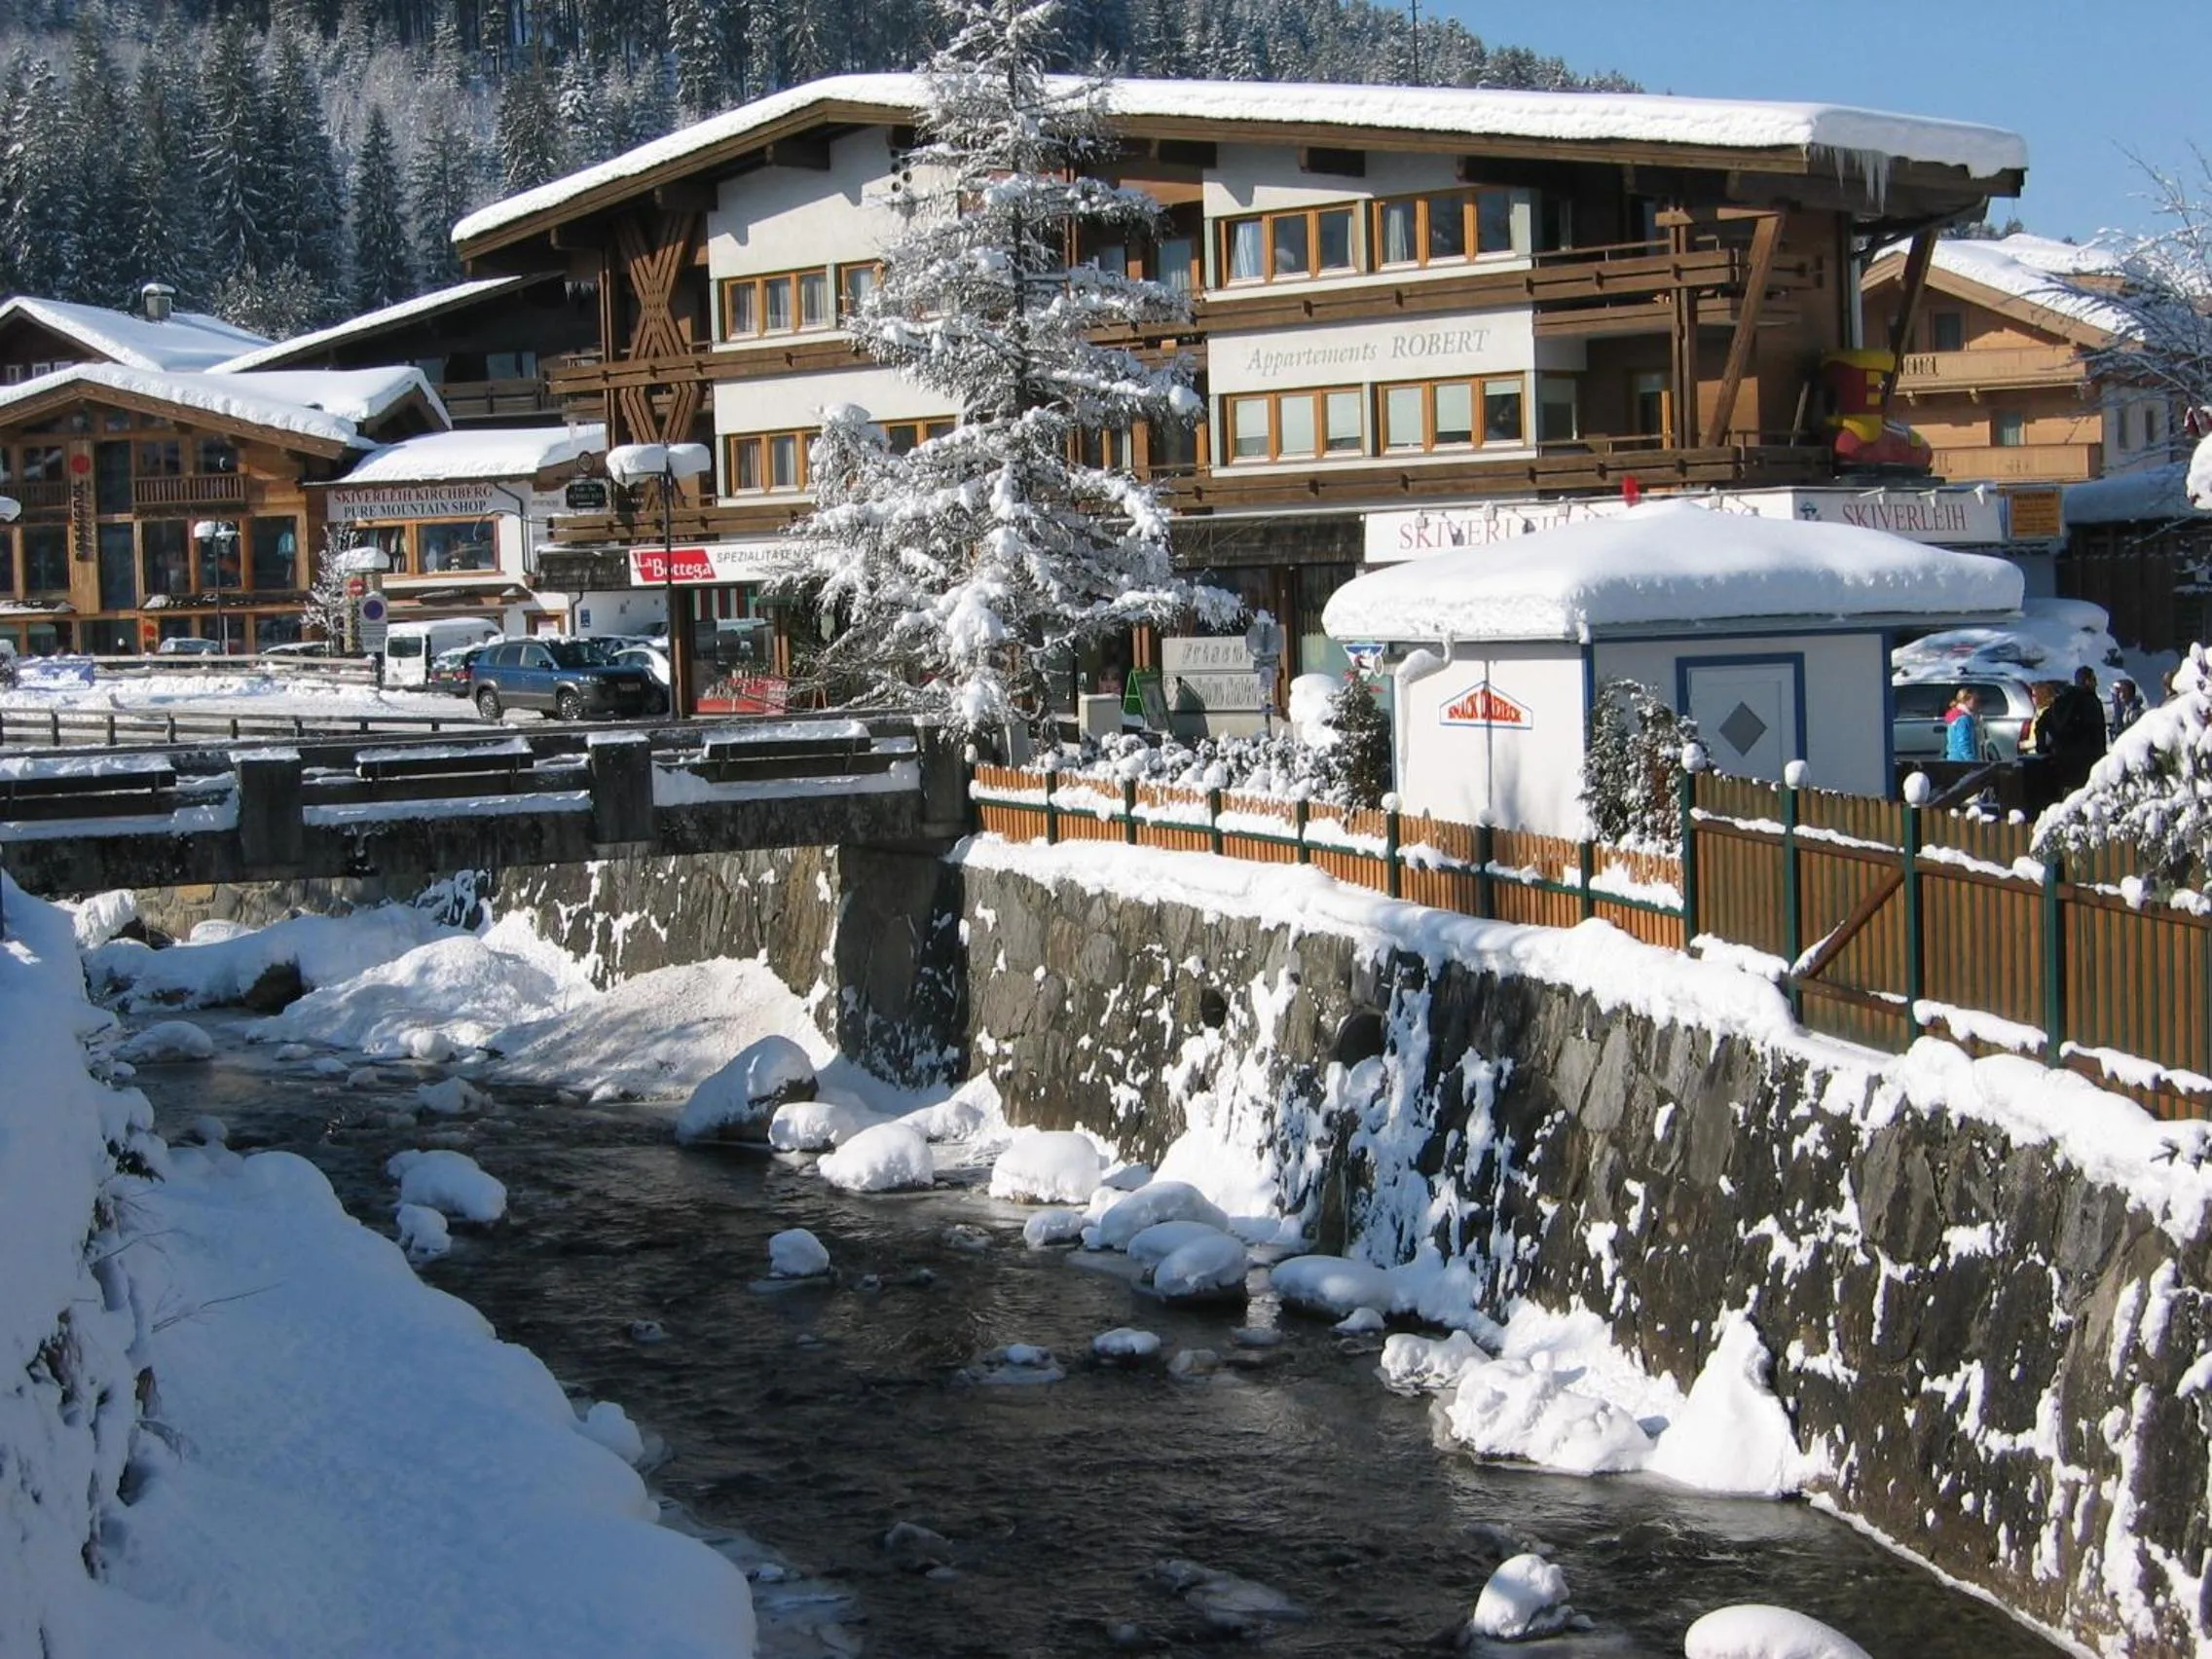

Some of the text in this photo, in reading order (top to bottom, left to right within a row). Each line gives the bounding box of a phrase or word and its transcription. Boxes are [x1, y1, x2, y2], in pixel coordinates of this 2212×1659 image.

[1246, 328, 1492, 377] Appartements ROBERT
[335, 484, 494, 503] SKIVERLEIH KIRCHBERG
[344, 499, 487, 519] PURE MOUNTAIN SHOP
[1842, 503, 1969, 532] SKIVERLEIH
[638, 552, 652, 568] La
[1448, 692, 1479, 719] SNACK
